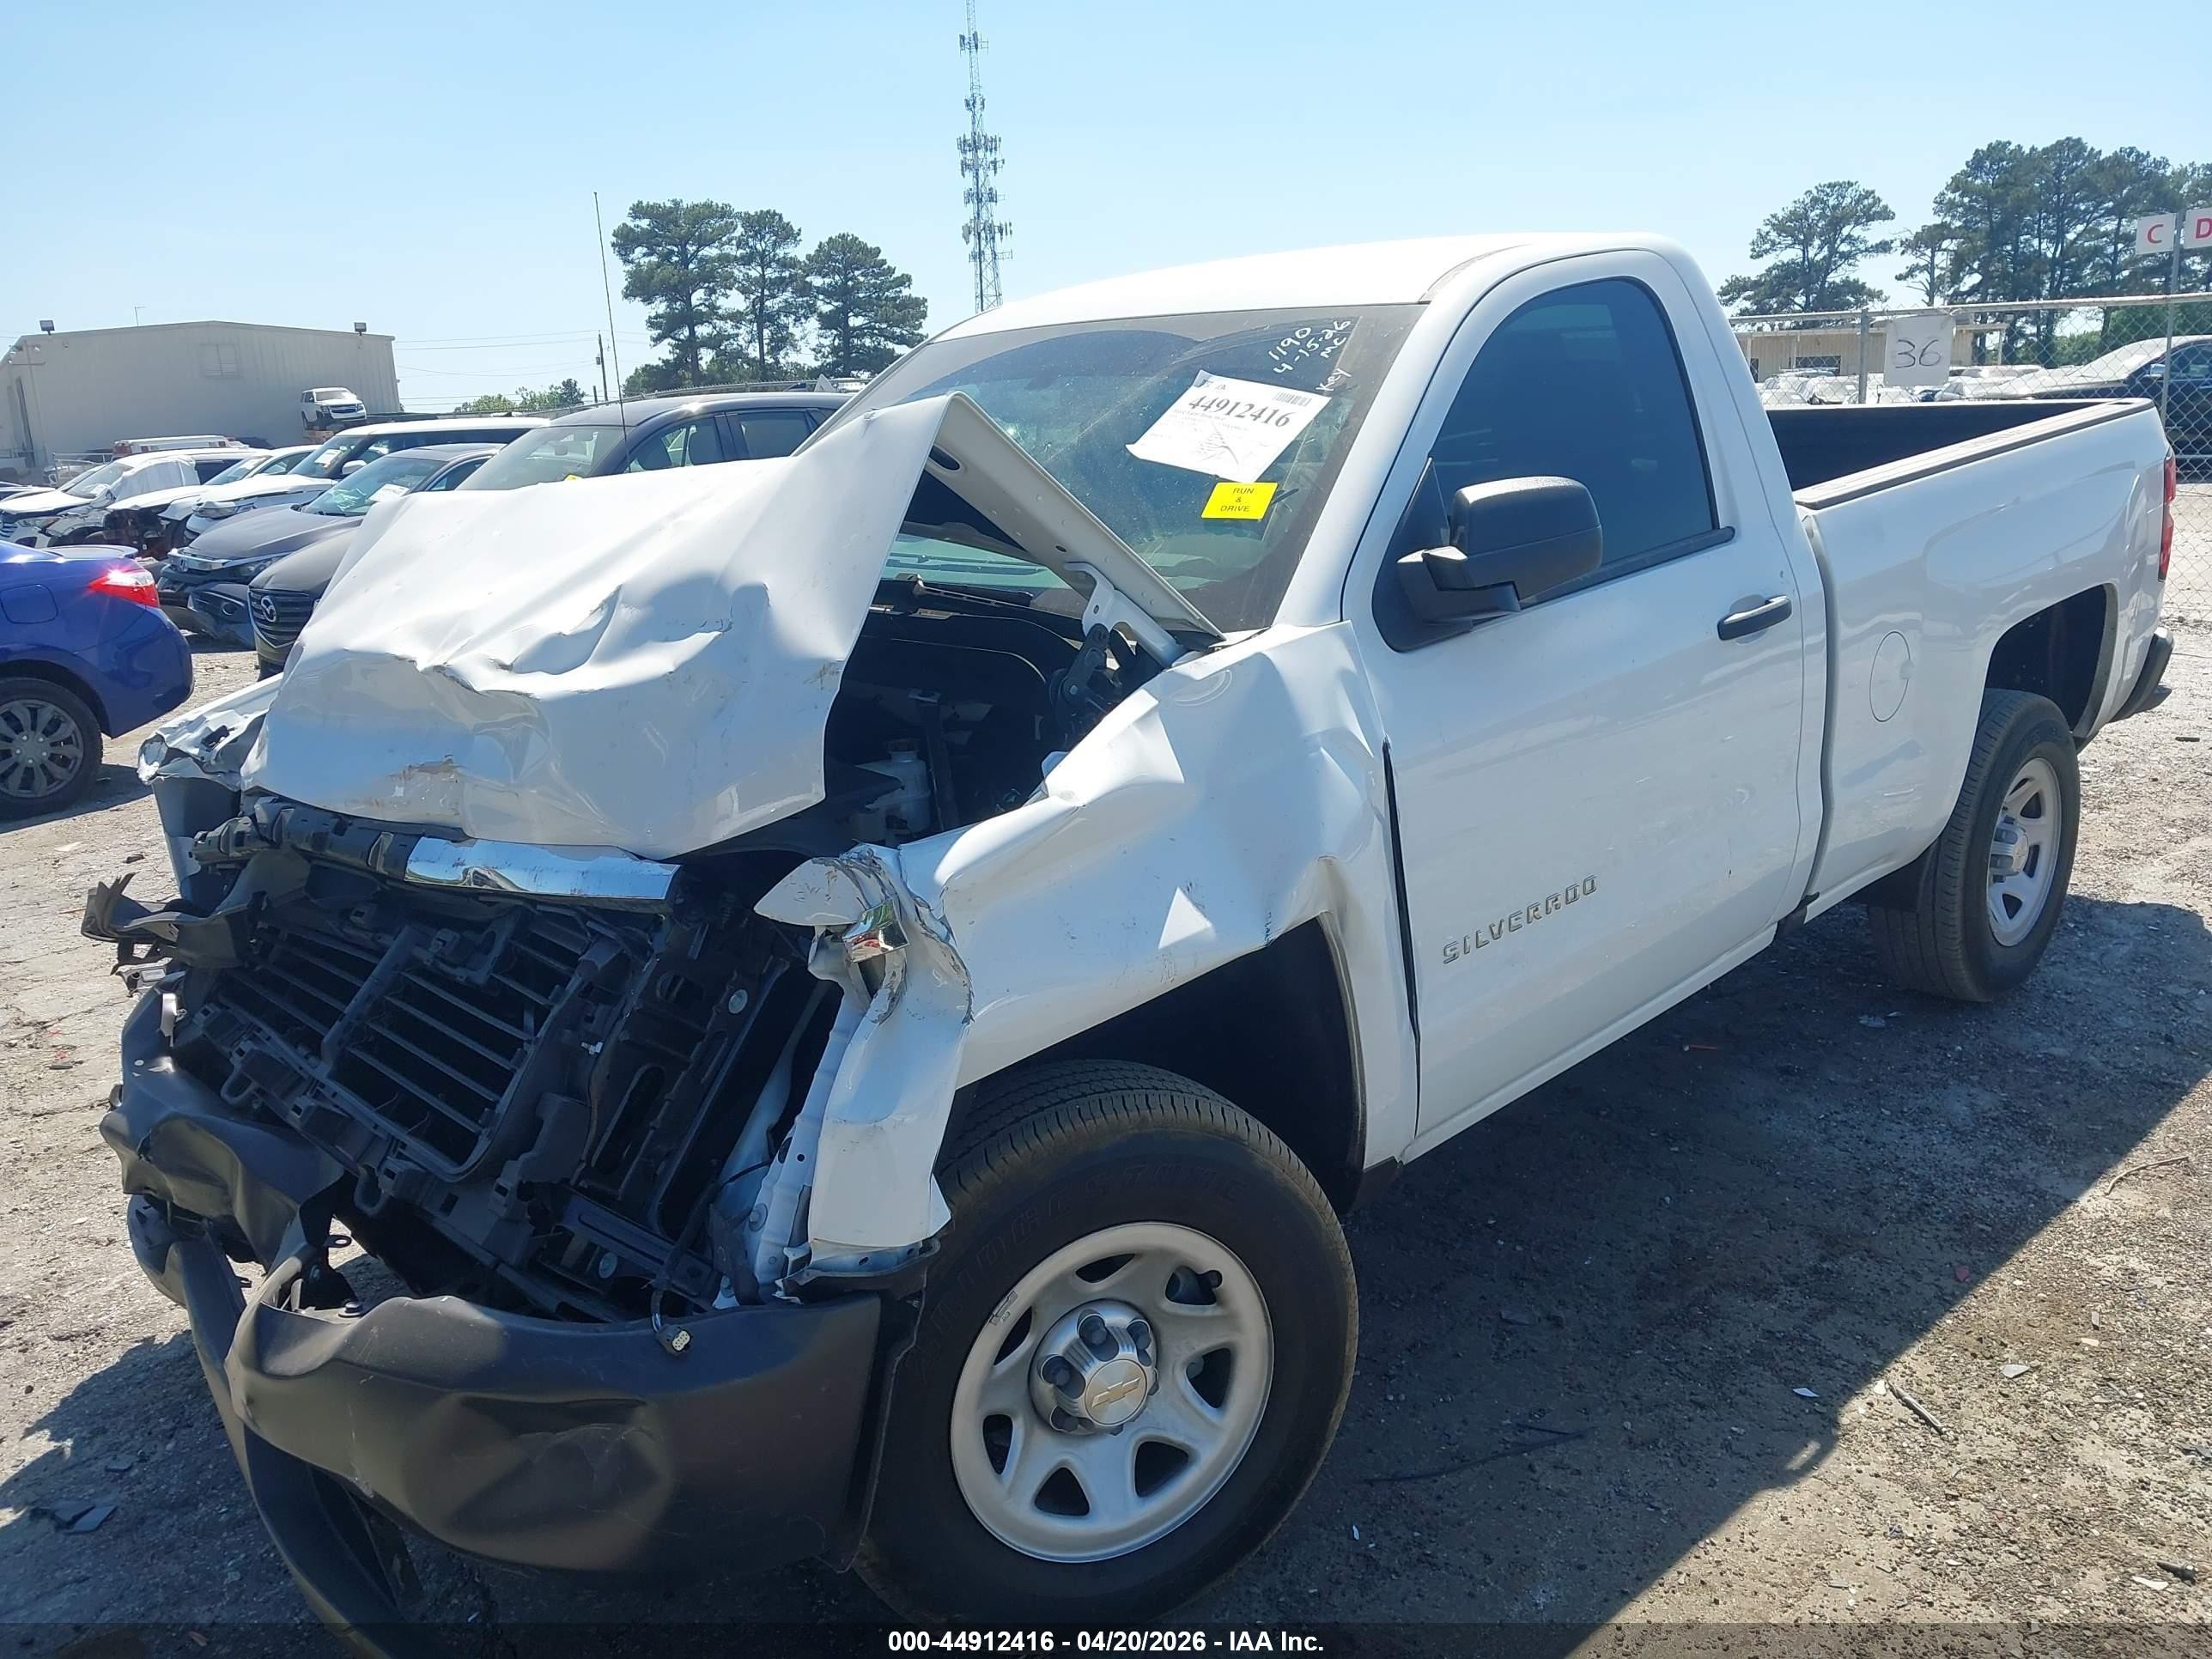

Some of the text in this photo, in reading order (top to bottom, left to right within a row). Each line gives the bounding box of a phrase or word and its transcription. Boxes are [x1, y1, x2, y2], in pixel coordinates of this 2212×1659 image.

[2146, 223, 2165, 245] C
[2195, 217, 2212, 240] D
[1267, 326, 1311, 361] 1190
[1894, 338, 1942, 368] 36
[1188, 395, 1297, 427] 44912416
[1442, 874, 1599, 965] SILVERADO
